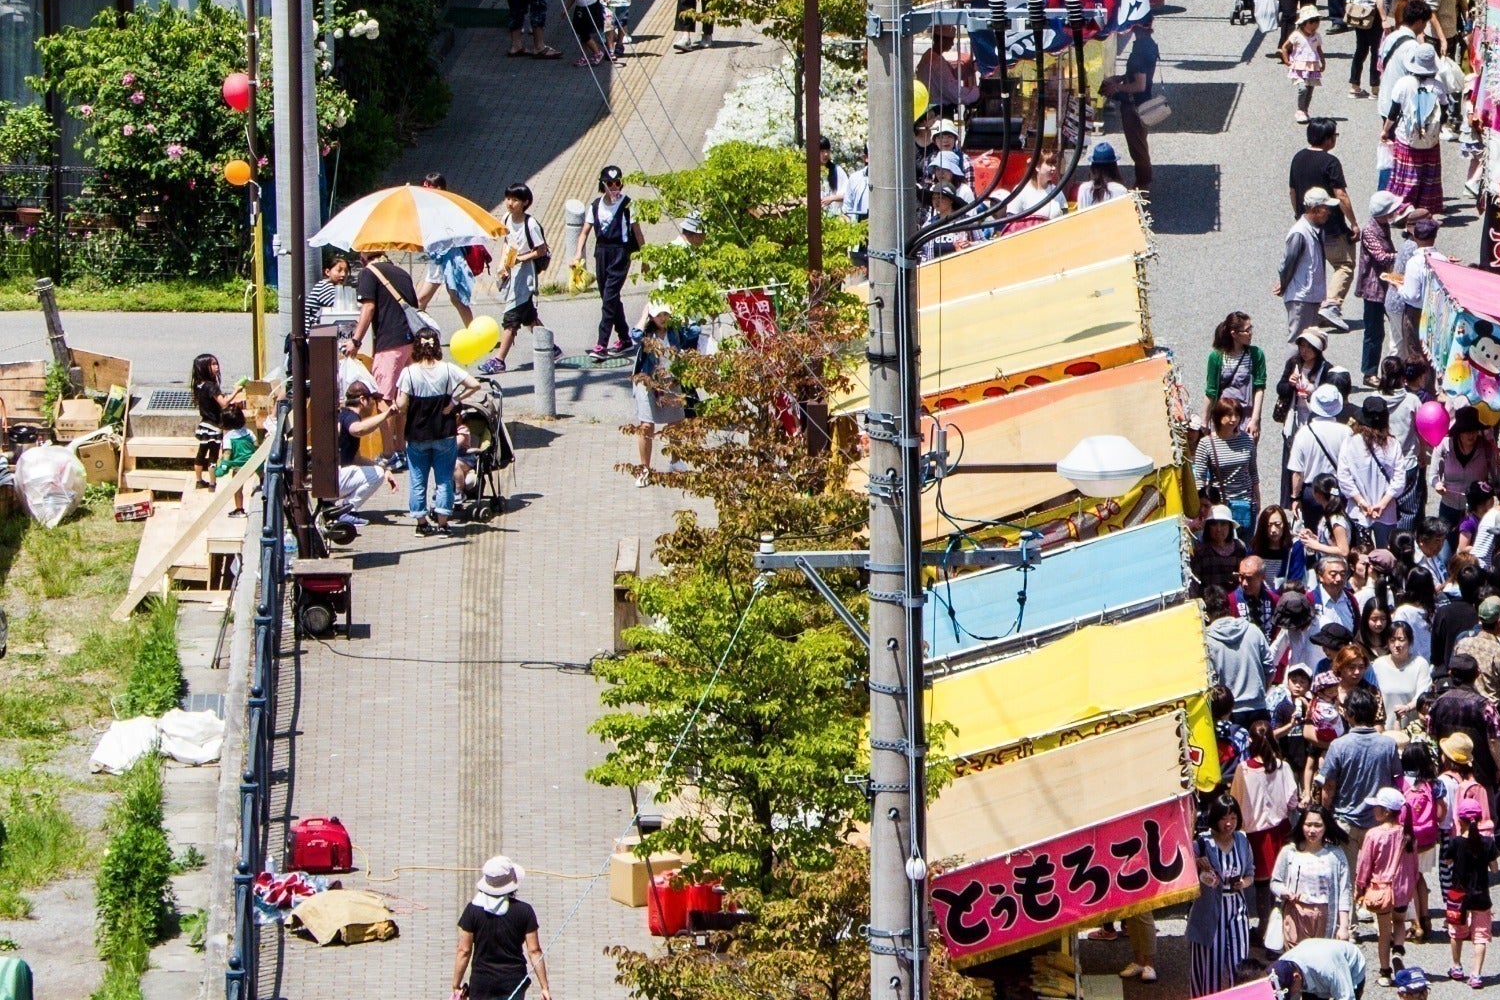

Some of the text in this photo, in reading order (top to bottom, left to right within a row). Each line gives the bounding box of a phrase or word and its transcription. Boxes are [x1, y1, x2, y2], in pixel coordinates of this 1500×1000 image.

[931, 818, 1185, 946] とうもろこし
